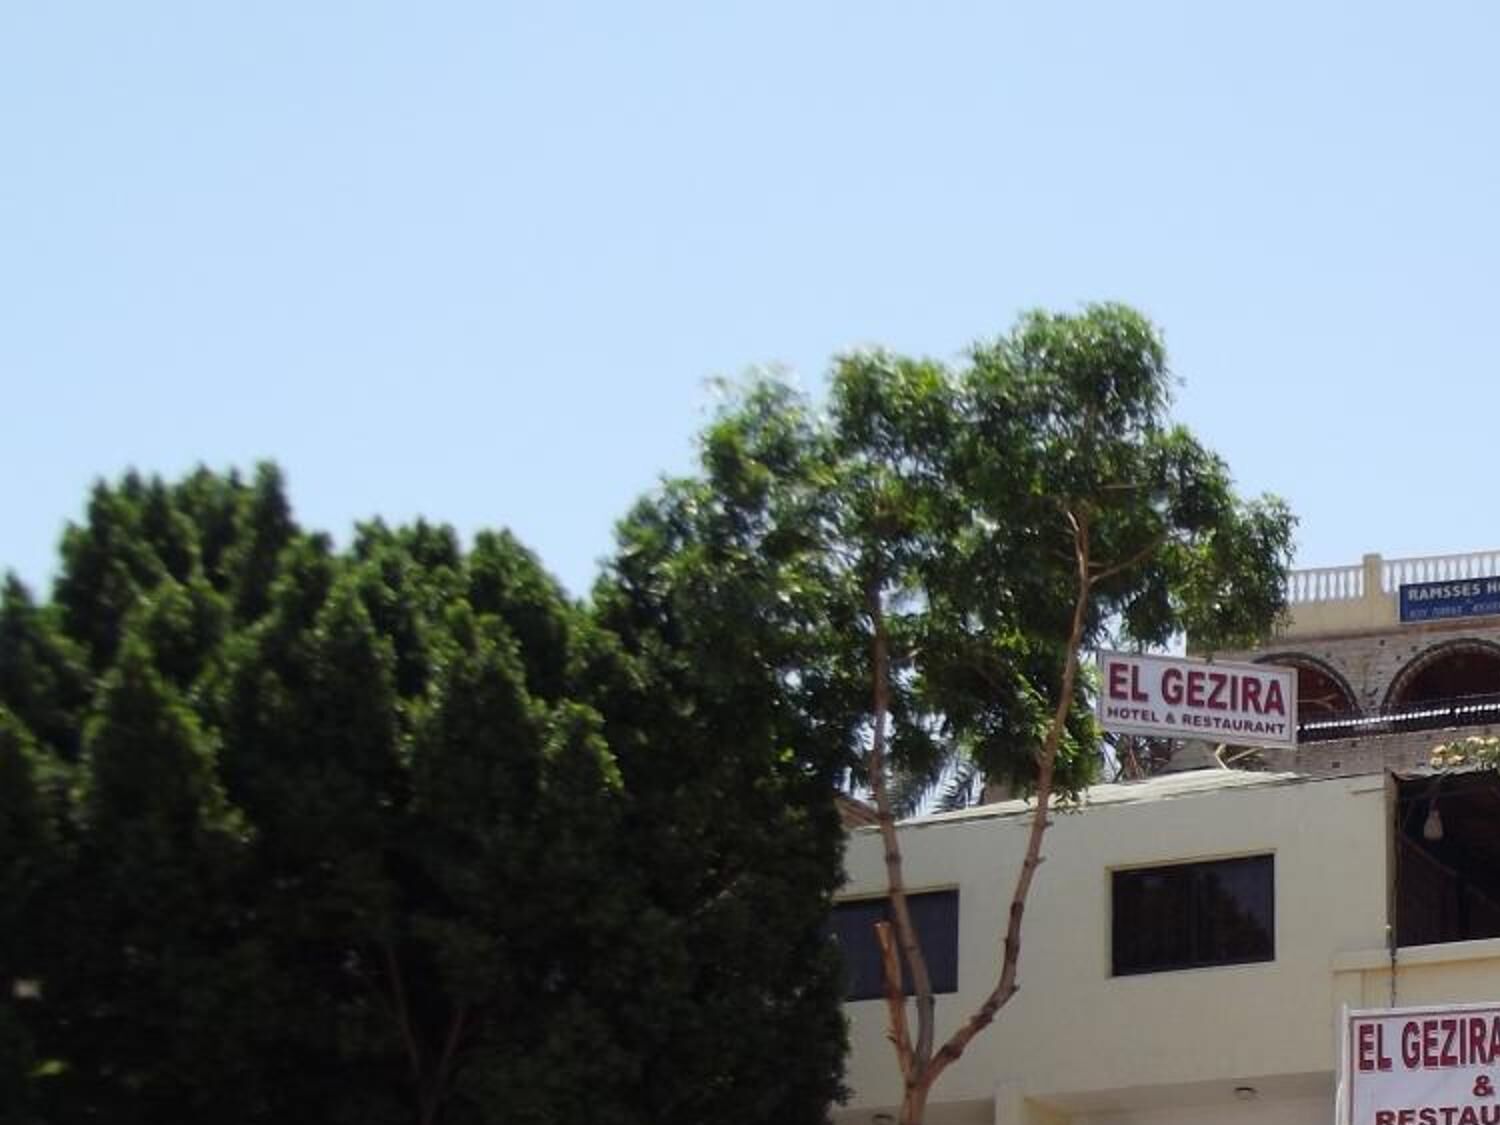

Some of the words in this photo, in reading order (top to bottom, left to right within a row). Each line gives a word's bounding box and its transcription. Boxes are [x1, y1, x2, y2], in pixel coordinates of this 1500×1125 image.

[1408, 583, 1481, 601] RAMSSES
[1109, 661, 1148, 703] EL
[1161, 667, 1286, 717] GEZIRA
[1107, 706, 1160, 723] HOTEL
[1165, 711, 1176, 724] &
[1182, 713, 1286, 735] RESTAURANT
[1358, 1023, 1393, 1072] EL
[1471, 1074, 1495, 1098] &
